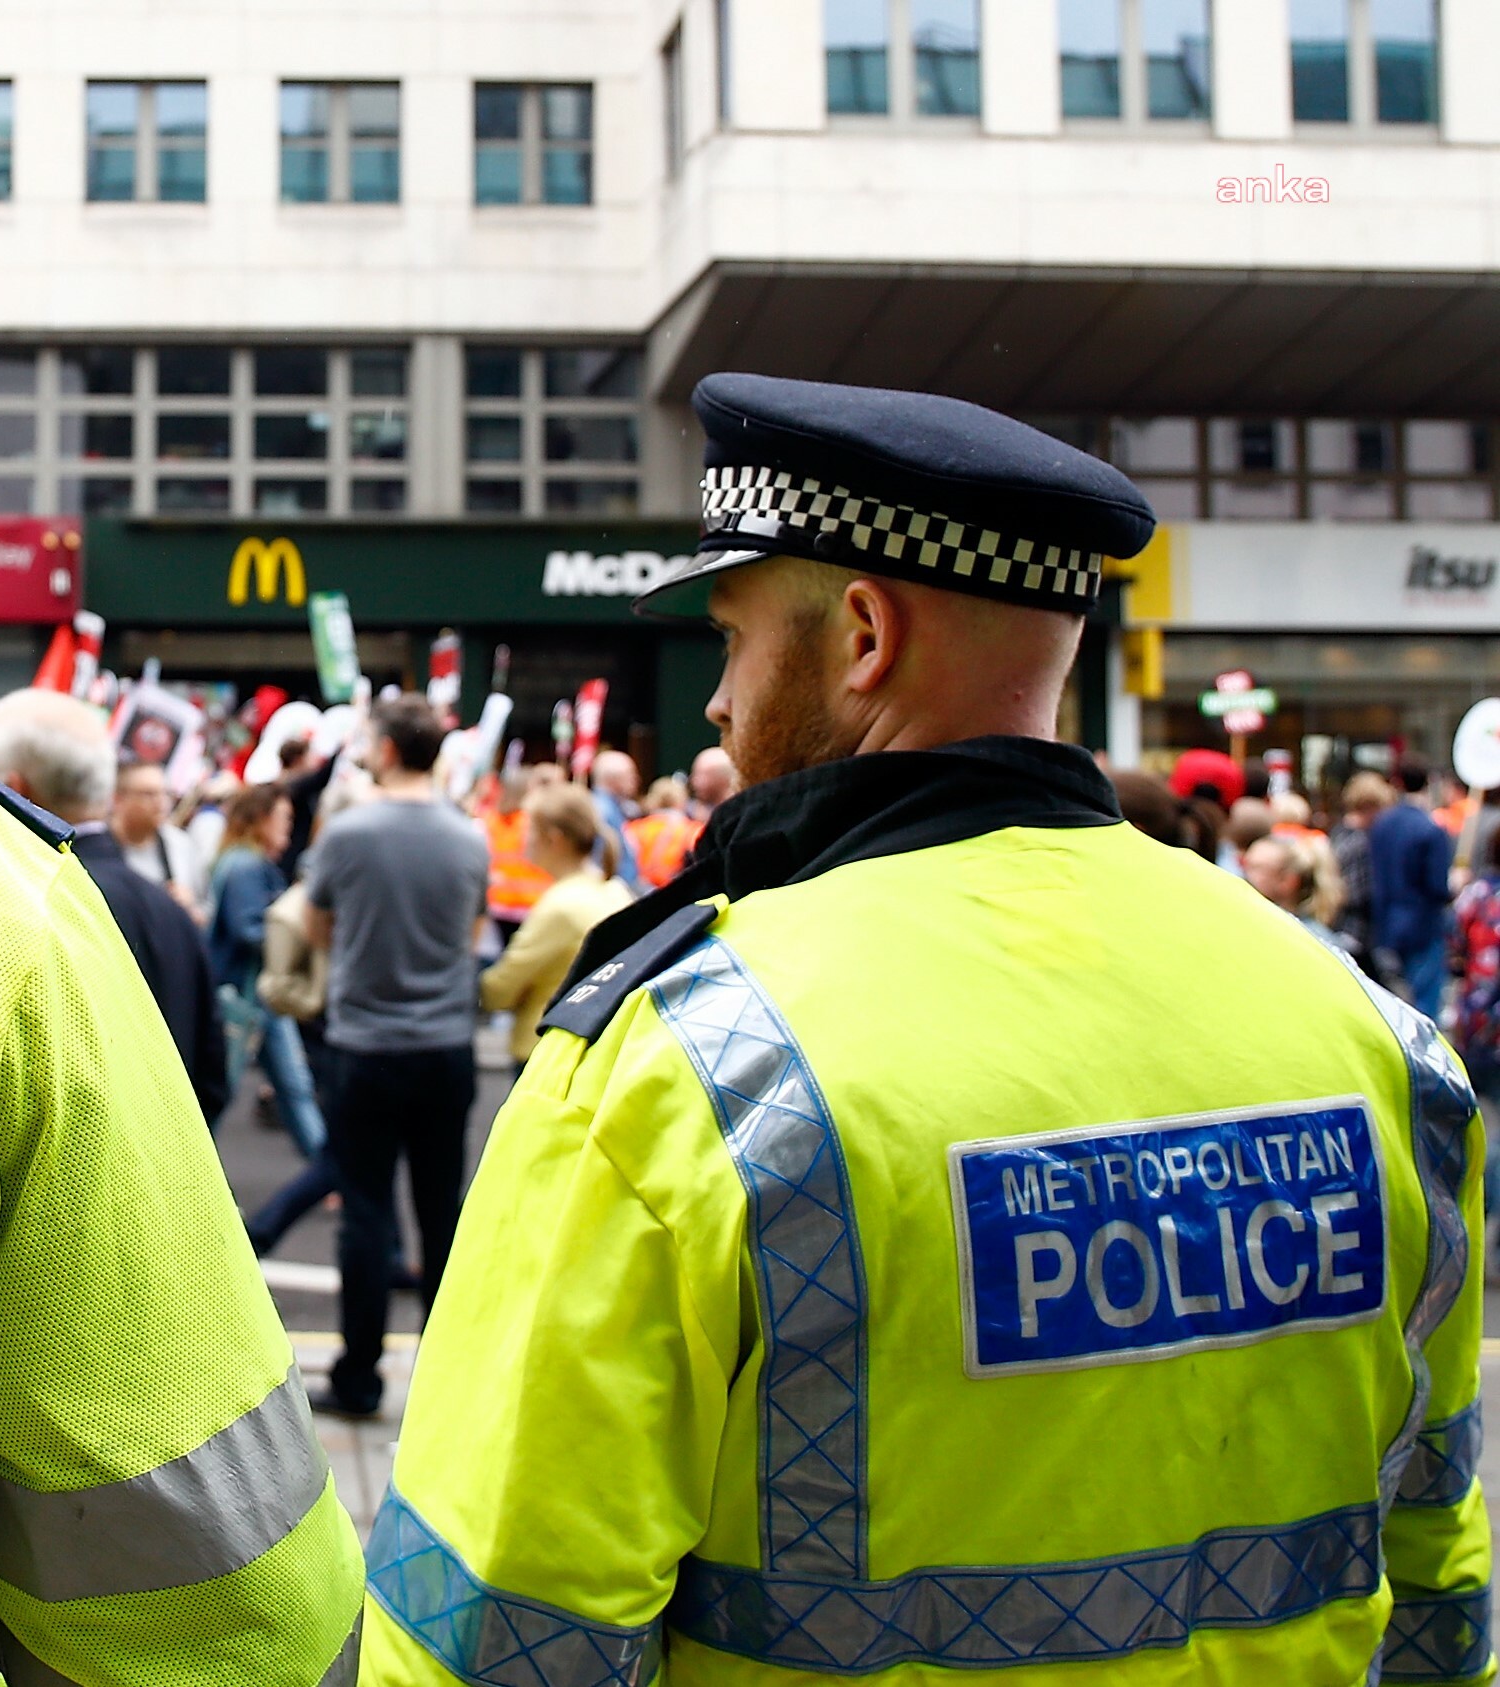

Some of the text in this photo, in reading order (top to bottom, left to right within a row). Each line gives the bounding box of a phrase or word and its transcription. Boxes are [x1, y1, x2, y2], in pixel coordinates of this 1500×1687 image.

[1405, 544, 1498, 592] itsu
[1002, 1126, 1355, 1217] METROPOLITAN
[1014, 1191, 1364, 1339] POLICE
